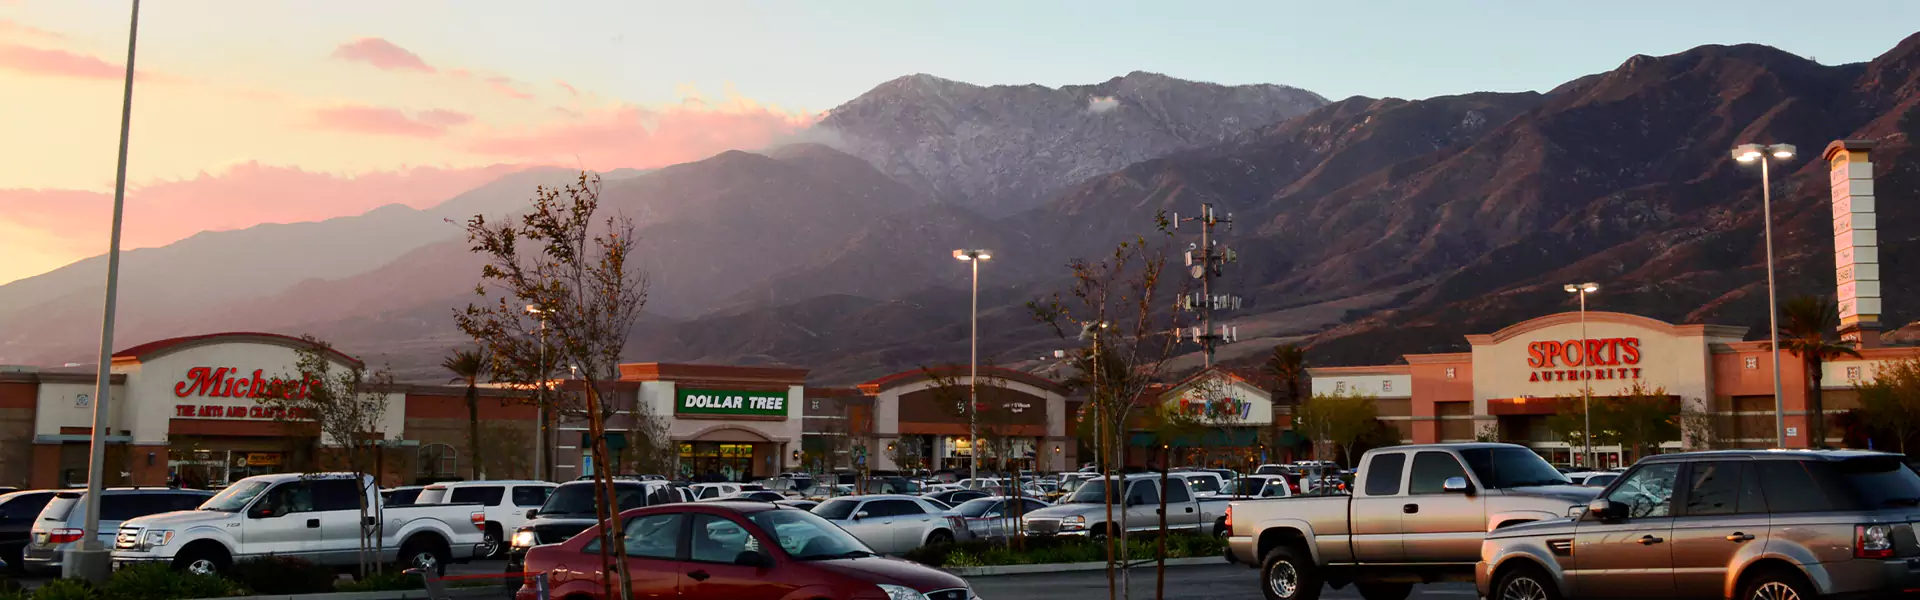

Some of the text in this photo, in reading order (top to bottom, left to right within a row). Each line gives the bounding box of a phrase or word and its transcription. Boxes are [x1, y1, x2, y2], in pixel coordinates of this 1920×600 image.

[1527, 337, 1640, 368] SPORTS
[1529, 367, 1641, 382] AUTHORITY
[685, 394, 784, 410] DOLLAR TREE
[176, 404, 197, 417] THE
[198, 404, 223, 417] ARTS
[226, 405, 248, 418] AND
